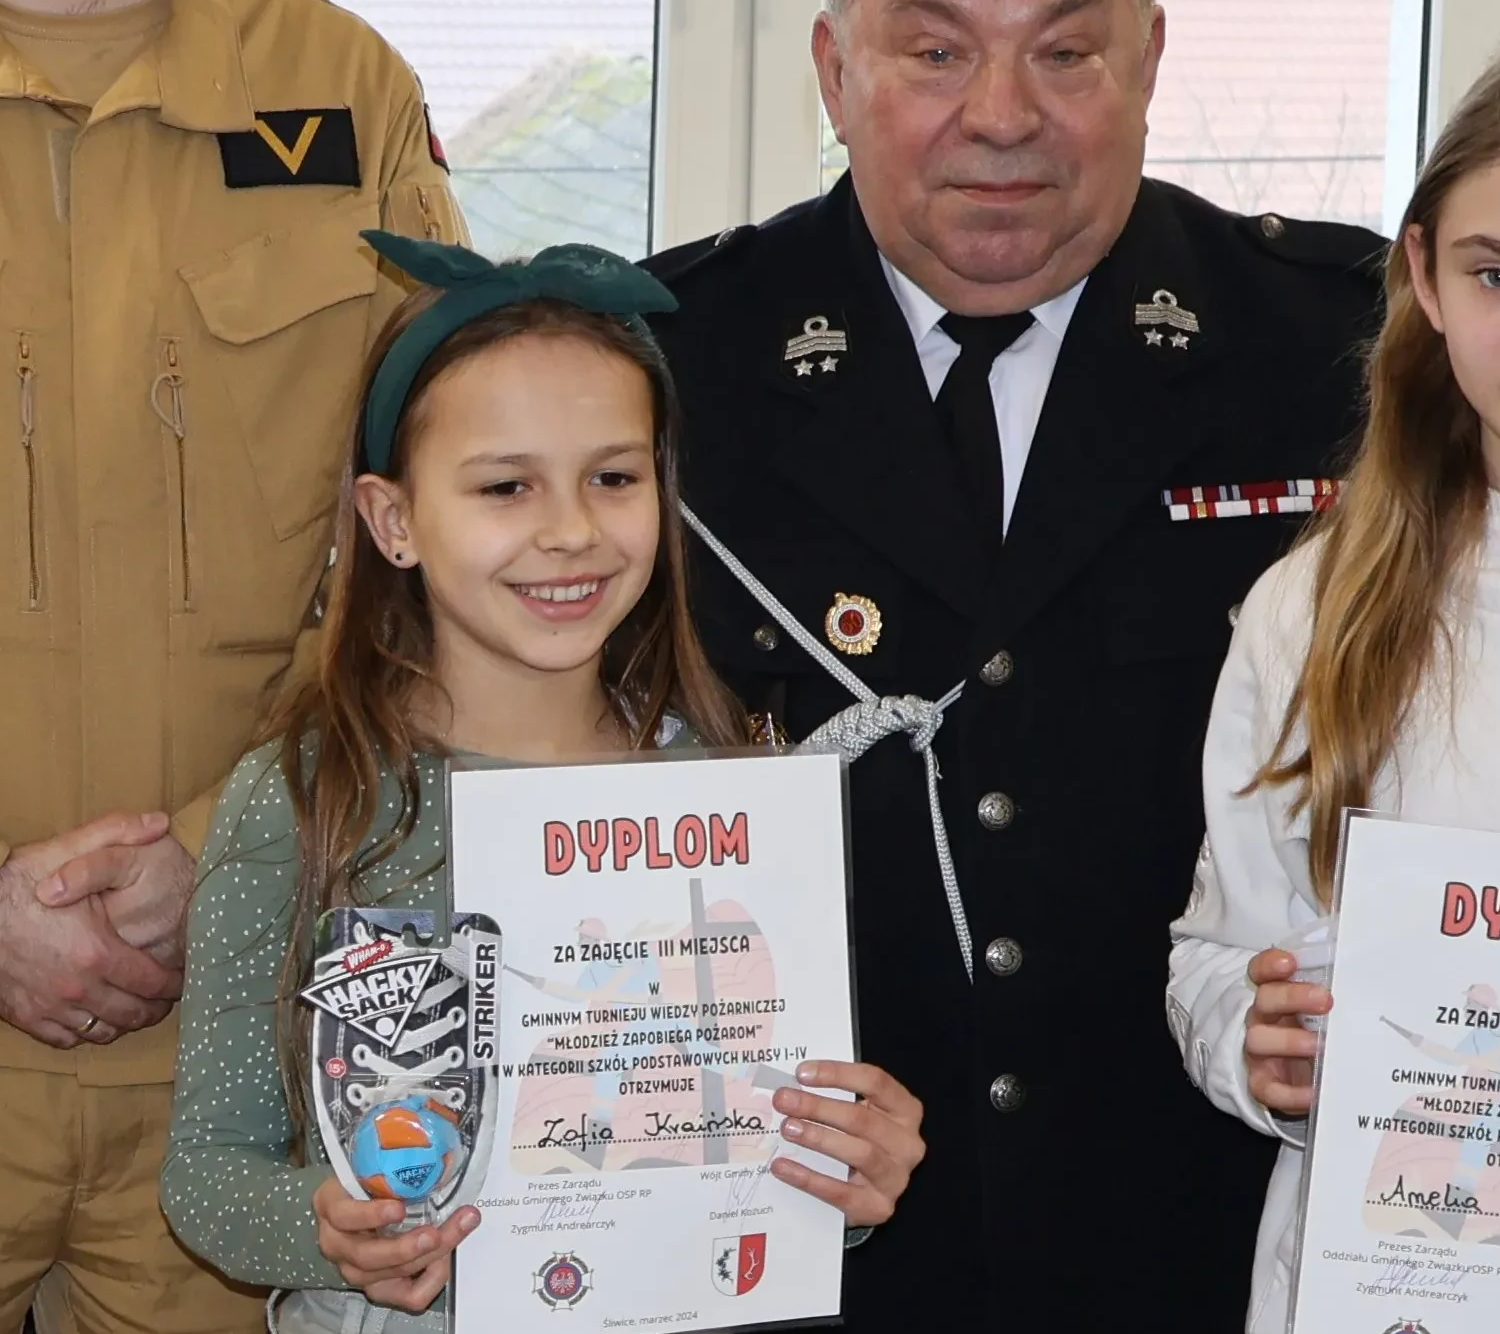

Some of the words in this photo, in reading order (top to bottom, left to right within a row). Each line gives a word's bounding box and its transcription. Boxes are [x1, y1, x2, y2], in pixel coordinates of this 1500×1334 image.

[543, 812, 750, 876] DYPLOM
[554, 945, 575, 963] ZA
[580, 941, 649, 964] ZAJĘCIE
[658, 939, 675, 957] III
[679, 935, 750, 956] MIEJSCA
[321, 963, 428, 1008] HACKY
[648, 982, 660, 995] W
[338, 987, 417, 1020] SACK
[473, 943, 496, 1060] STRIKER
[521, 1011, 582, 1028] GMINNYM
[585, 1008, 647, 1024] TURNIEJU
[650, 1004, 698, 1020] WIEDZY
[702, 998, 786, 1017] POŻARNICZEJ
[1436, 1006, 1459, 1025] ZA
[622, 1029, 692, 1047] ZAPOBIEGA
[502, 1065, 514, 1078] W
[518, 1060, 584, 1077] KATEGORII
[588, 1054, 628, 1073] SZKÓŁ
[632, 1051, 739, 1070] PODSTAWOWYCH
[742, 1048, 781, 1064] KLASY
[785, 1046, 807, 1061] I-IV
[619, 1078, 695, 1095] OTRZYMUJE
[1391, 1068, 1457, 1088] GMINNYM
[537, 1113, 614, 1152] Zofia
[1358, 1115, 1370, 1129] W
[1374, 1117, 1445, 1137] KATEGORII
[1449, 1123, 1493, 1142] SZKÓŁ
[528, 1181, 560, 1191] Prezes
[562, 1178, 602, 1190] Zarządu
[1380, 1174, 1483, 1213] Amelia
[476, 1197, 519, 1208] Oddziału
[523, 1194, 572, 1206] Gminnego
[616, 1190, 636, 1200] OSP
[639, 1189, 652, 1198] RP
[510, 1223, 553, 1235] Zygmunt
[1378, 1241, 1413, 1253] Prezes
[1415, 1244, 1457, 1258] Zarządu
[1322, 1250, 1368, 1263] Oddziału
[1371, 1255, 1425, 1270] Gminnego
[1472, 1265, 1494, 1275] OSP
[1356, 1282, 1401, 1296] Zygmunt
[640, 1314, 674, 1325] marzec
[676, 1311, 698, 1322] 2024
